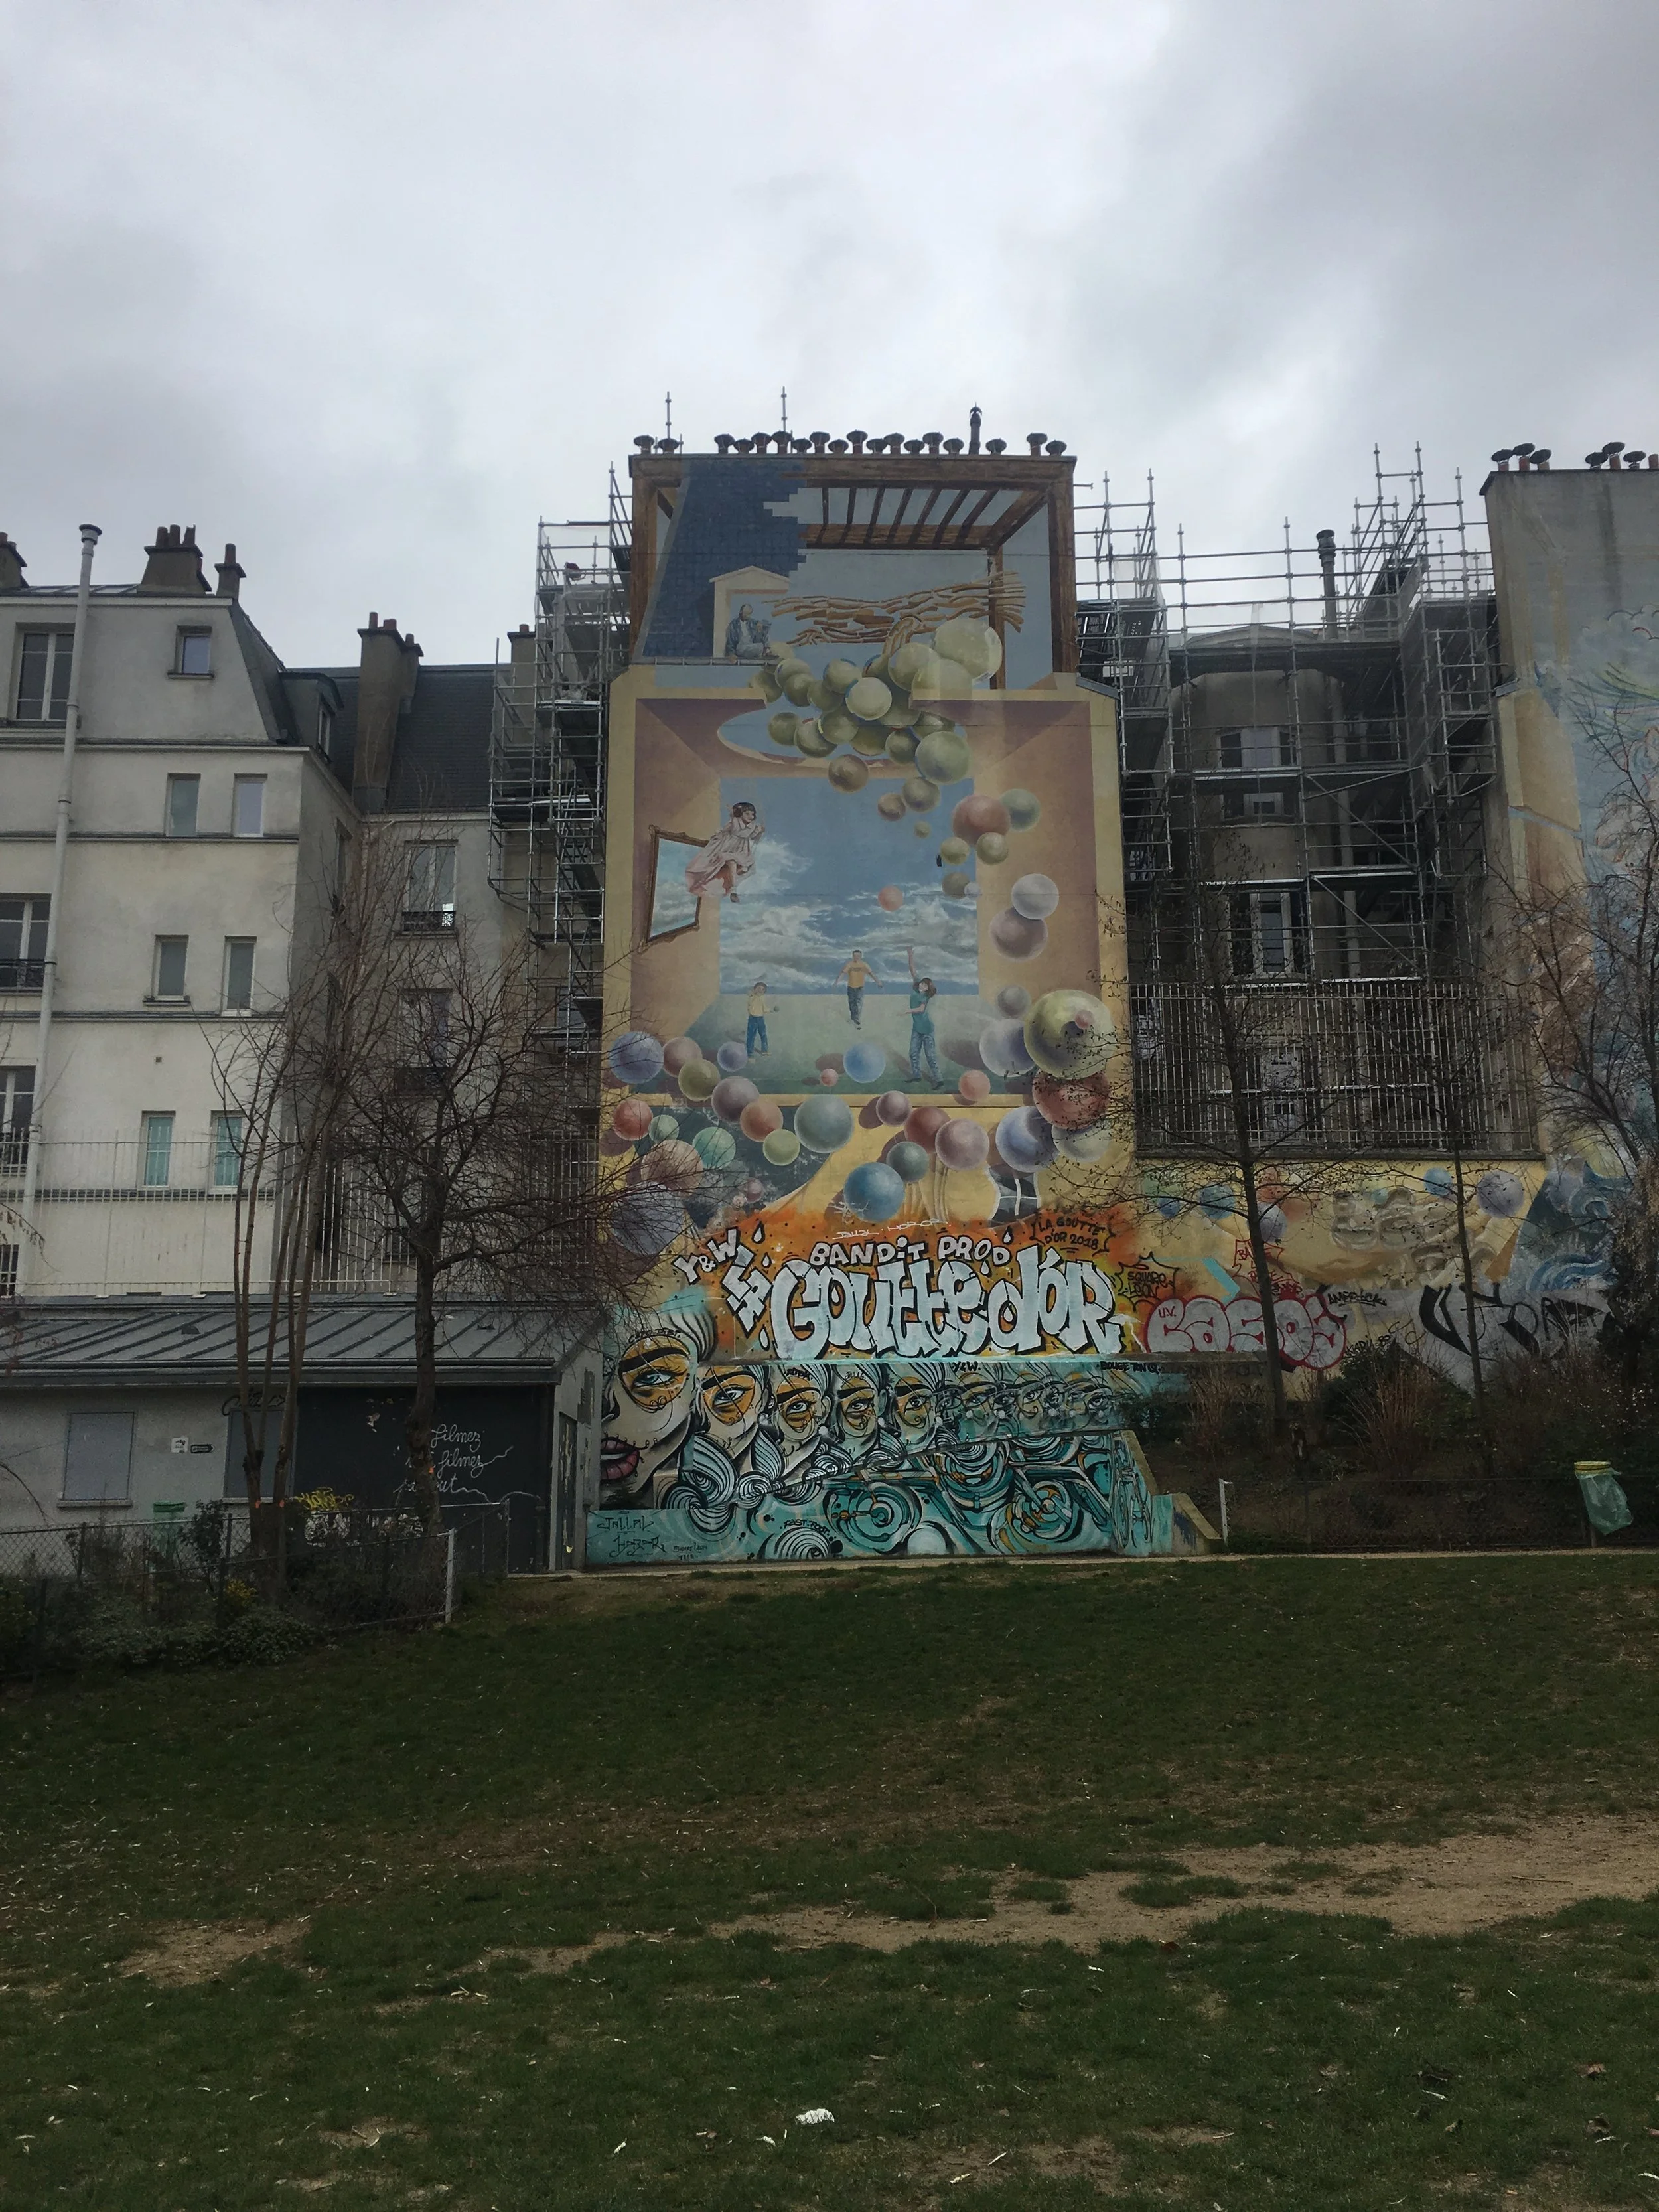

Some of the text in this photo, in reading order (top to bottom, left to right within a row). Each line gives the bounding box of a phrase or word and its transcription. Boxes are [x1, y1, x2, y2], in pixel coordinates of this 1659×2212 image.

[1039, 1219, 1053, 1232] LA
[1045, 1231, 1099, 1250] D'OR 2018
[938, 1235, 1012, 1266] PROD
